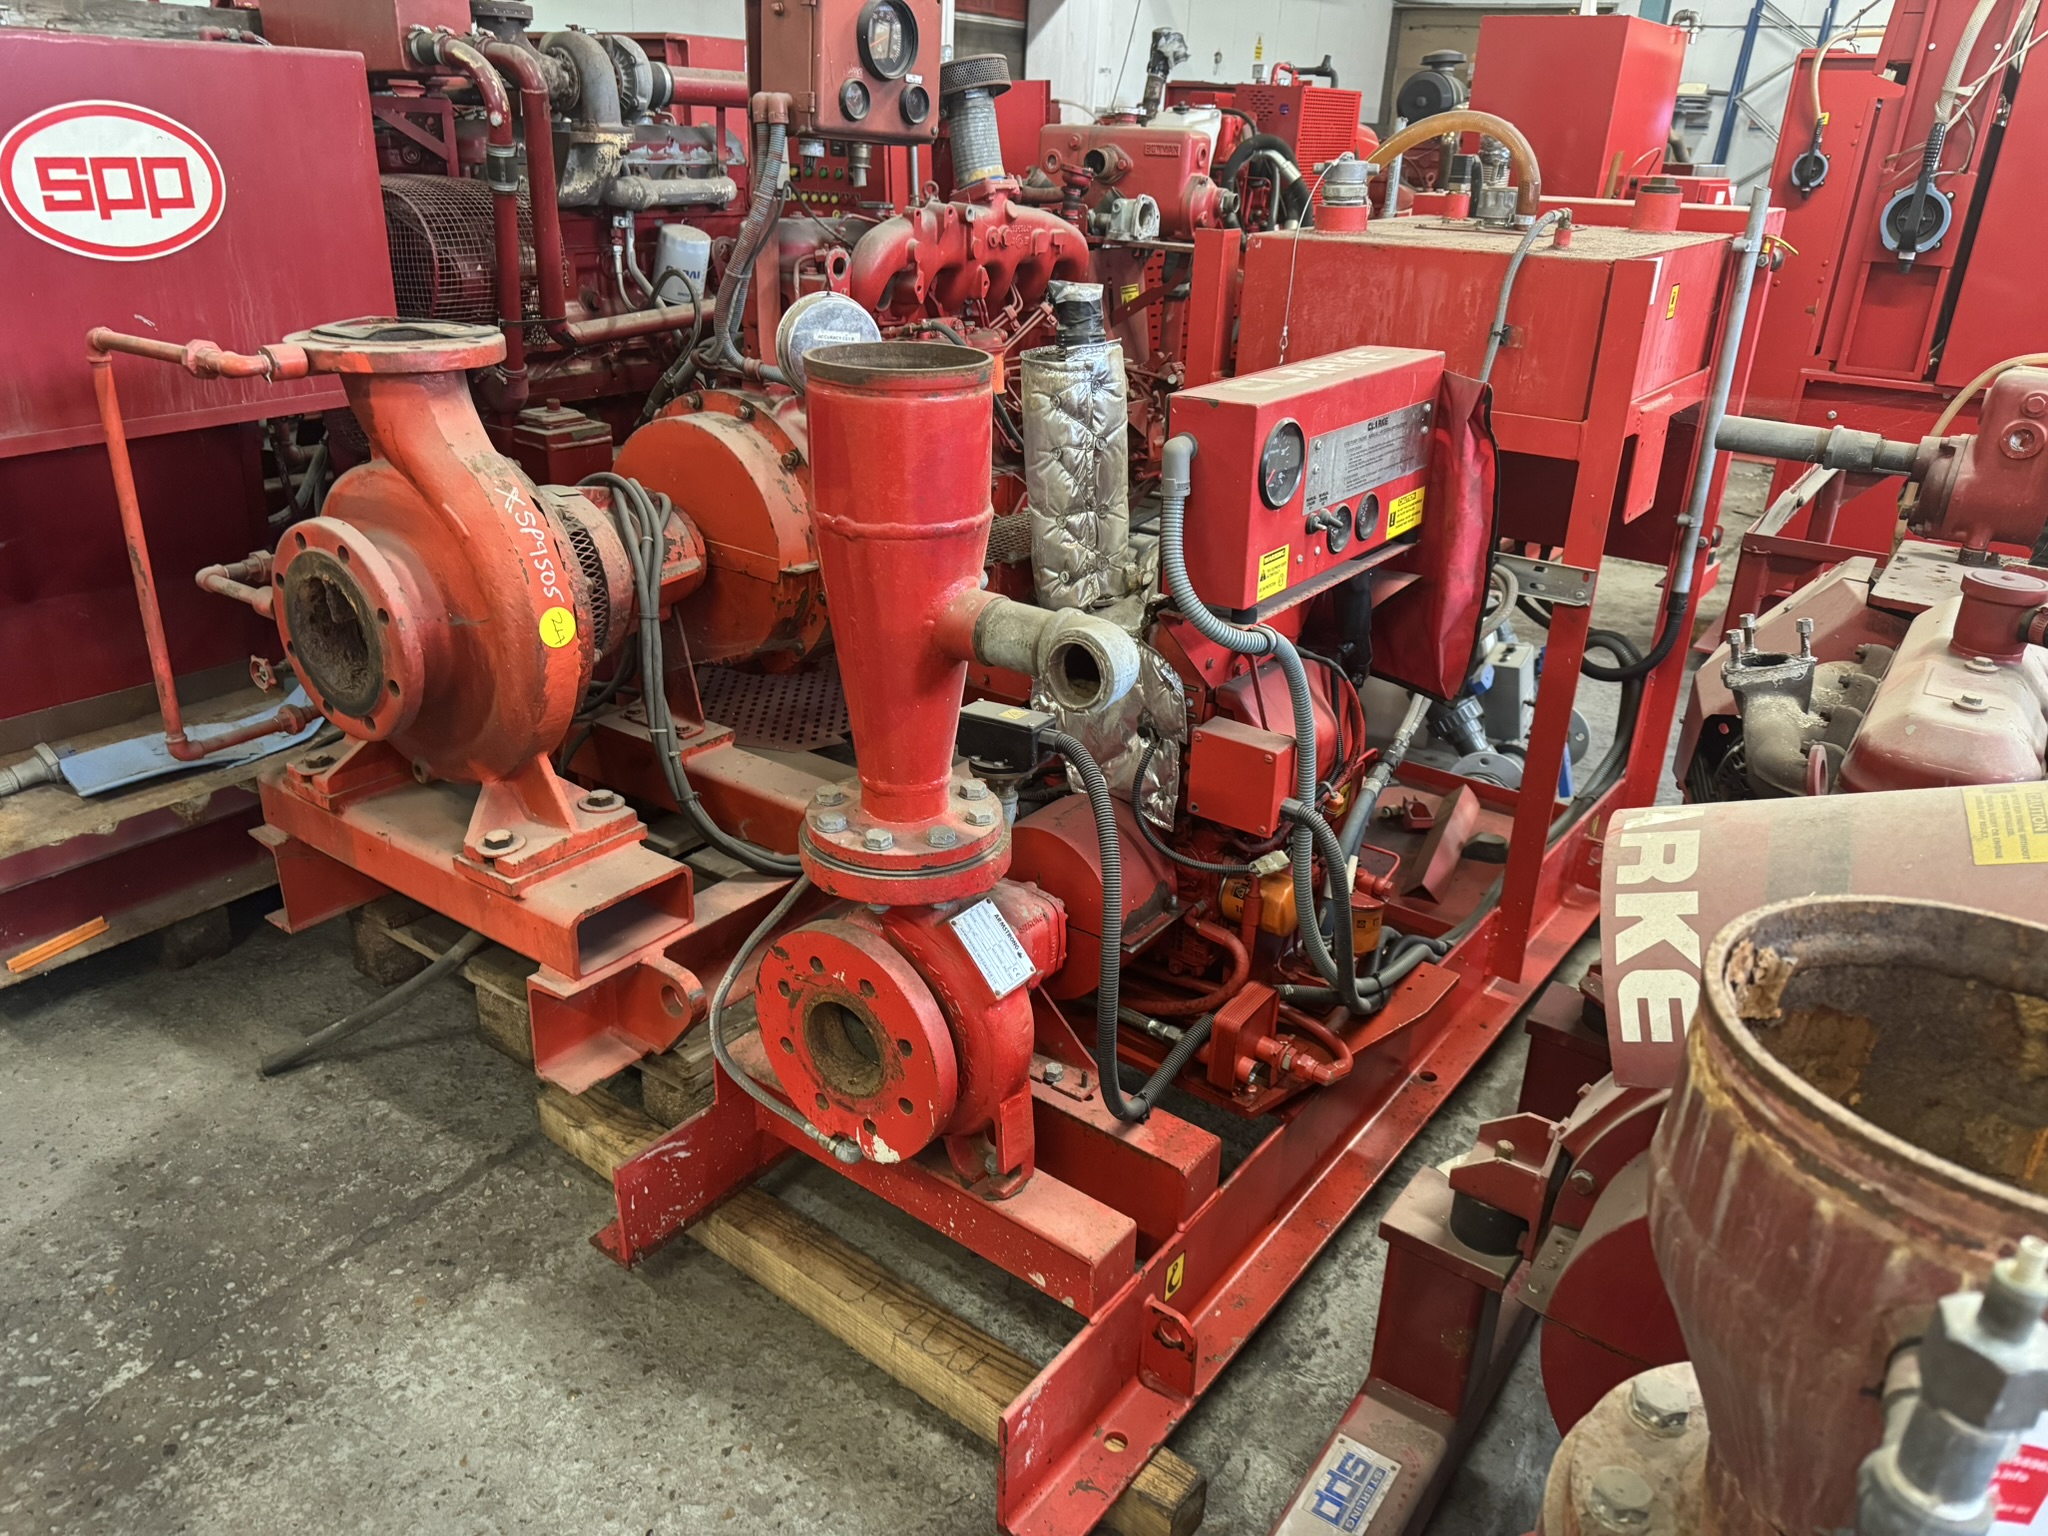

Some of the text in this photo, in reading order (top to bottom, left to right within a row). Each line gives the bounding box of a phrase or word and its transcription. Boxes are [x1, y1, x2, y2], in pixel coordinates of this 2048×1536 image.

[1222, 350, 1393, 392] CLARKE
[1367, 416, 1389, 432] CLARKE
[2025, 792, 2047, 832] CAUTION
[993, 912, 1020, 951] ARMSTRONG
[1344, 1468, 1385, 1530] STERLING
